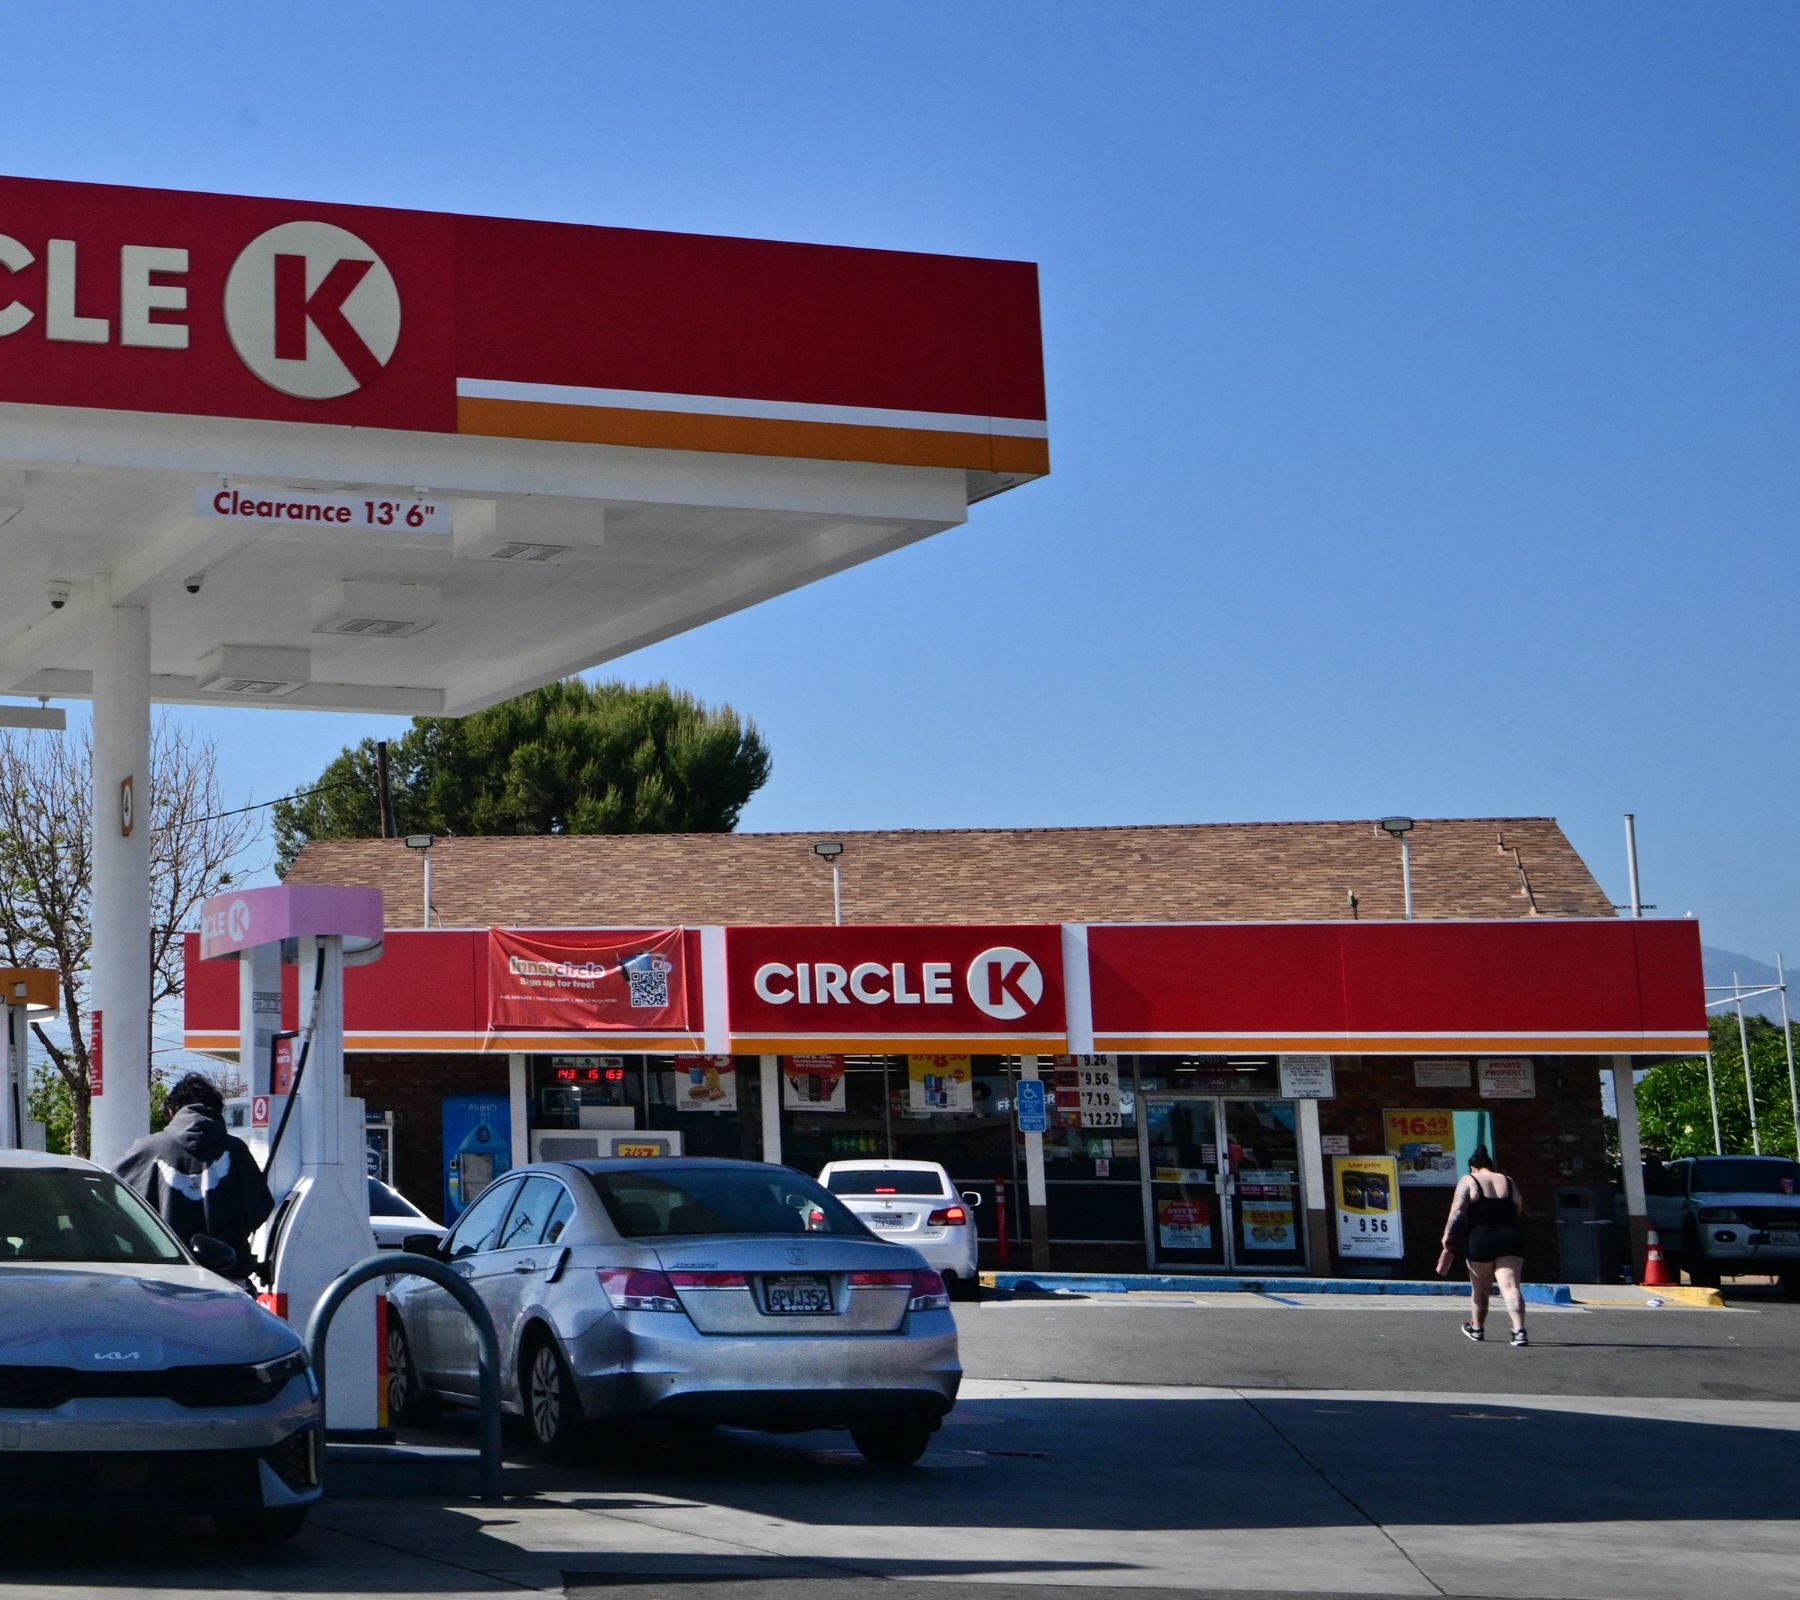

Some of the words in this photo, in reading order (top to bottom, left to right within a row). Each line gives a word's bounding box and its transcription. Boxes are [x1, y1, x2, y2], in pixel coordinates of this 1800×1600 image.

[274, 253, 386, 389] K
[213, 490, 352, 523] Clearance
[510, 958, 603, 977] innercircle
[520, 977, 541, 986] Sign
[543, 979, 556, 988] up
[572, 980, 595, 989] free!
[754, 962, 953, 1004] CIRCLE
[986, 961, 1040, 1015] K
[557, 1069, 576, 1079] 143
[588, 1069, 599, 1079] 15
[605, 1069, 624, 1080] 163
[1427, 1128, 1449, 1136] each
[771, 1289, 829, 1306] 6PVJ352
